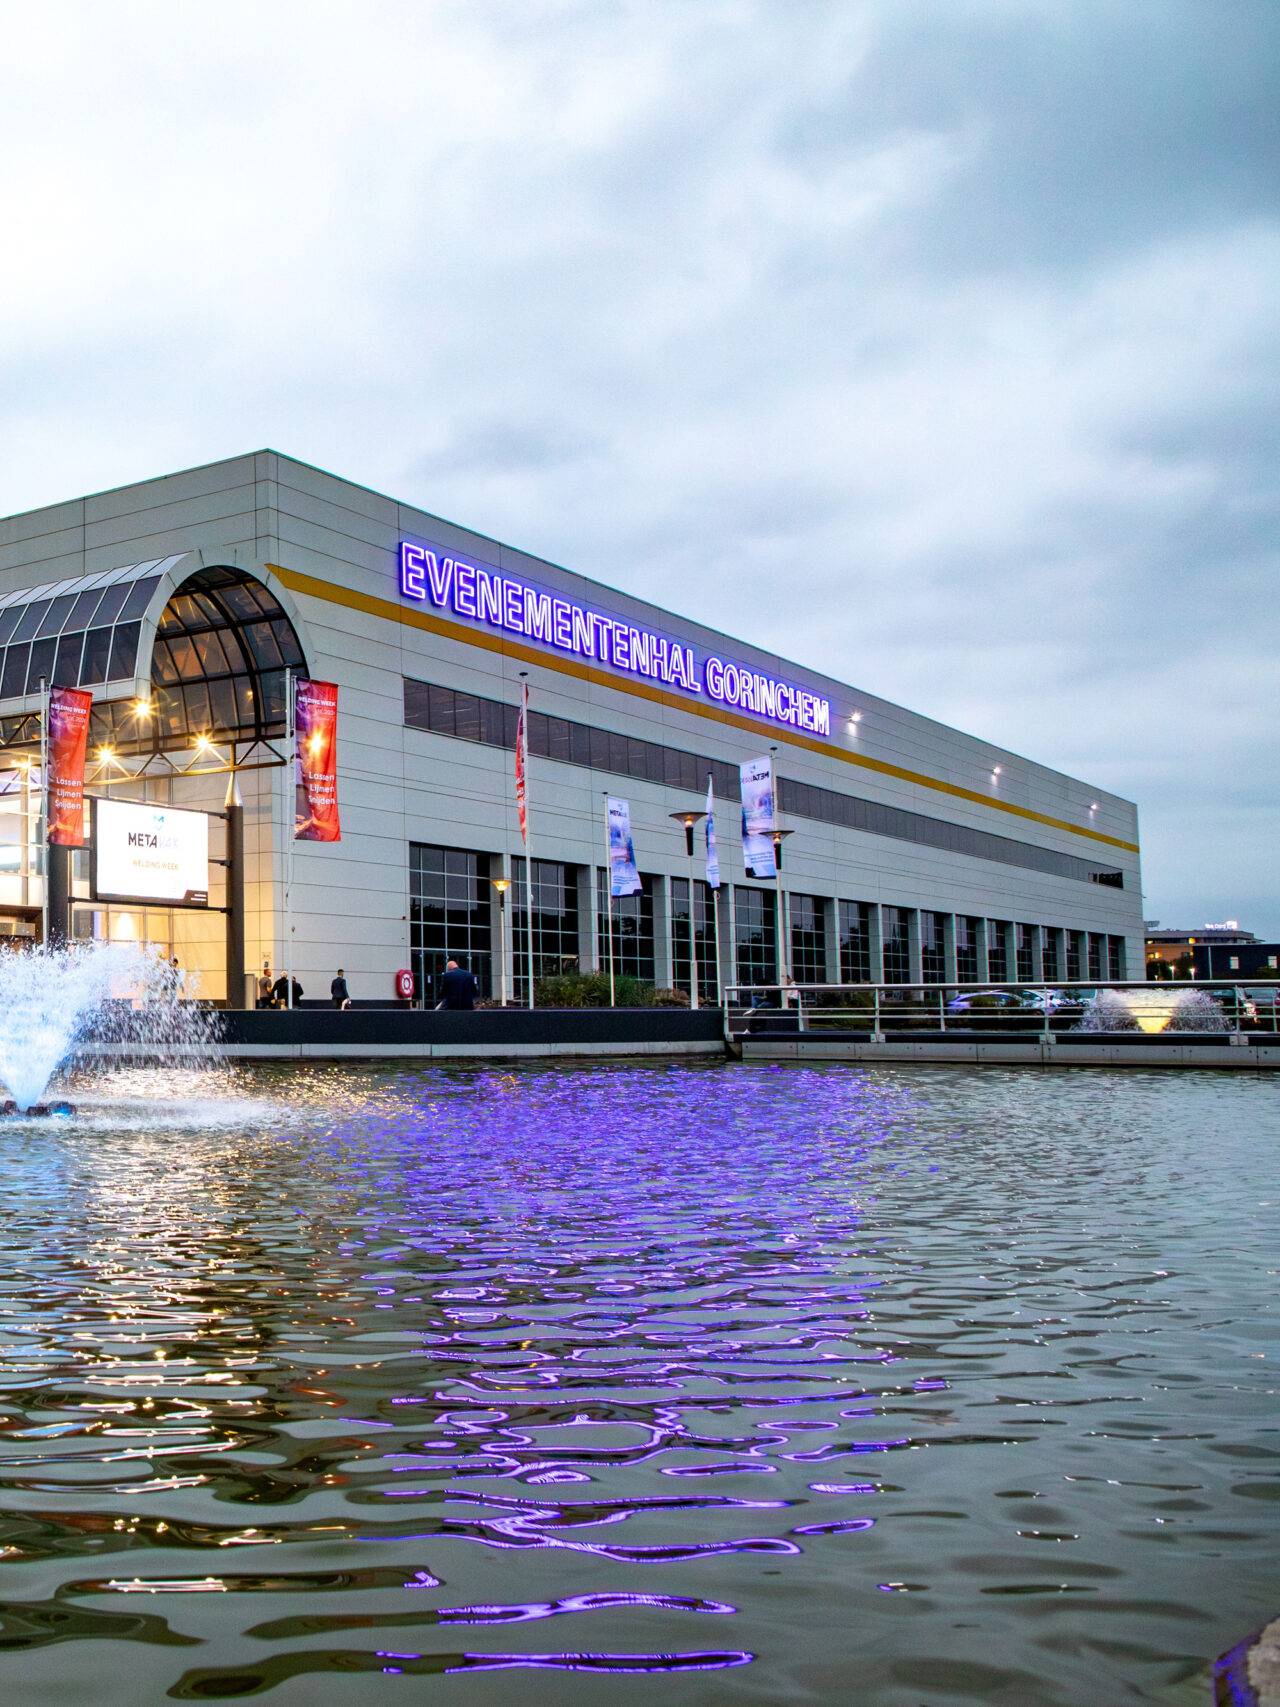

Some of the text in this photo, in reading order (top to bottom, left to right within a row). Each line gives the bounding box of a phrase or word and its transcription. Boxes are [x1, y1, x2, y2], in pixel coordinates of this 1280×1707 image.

[399, 541, 831, 737] EVENEMENTENHAL GORINCHEM
[56, 776, 82, 787] Lassen
[56, 788, 82, 798] Lijmen
